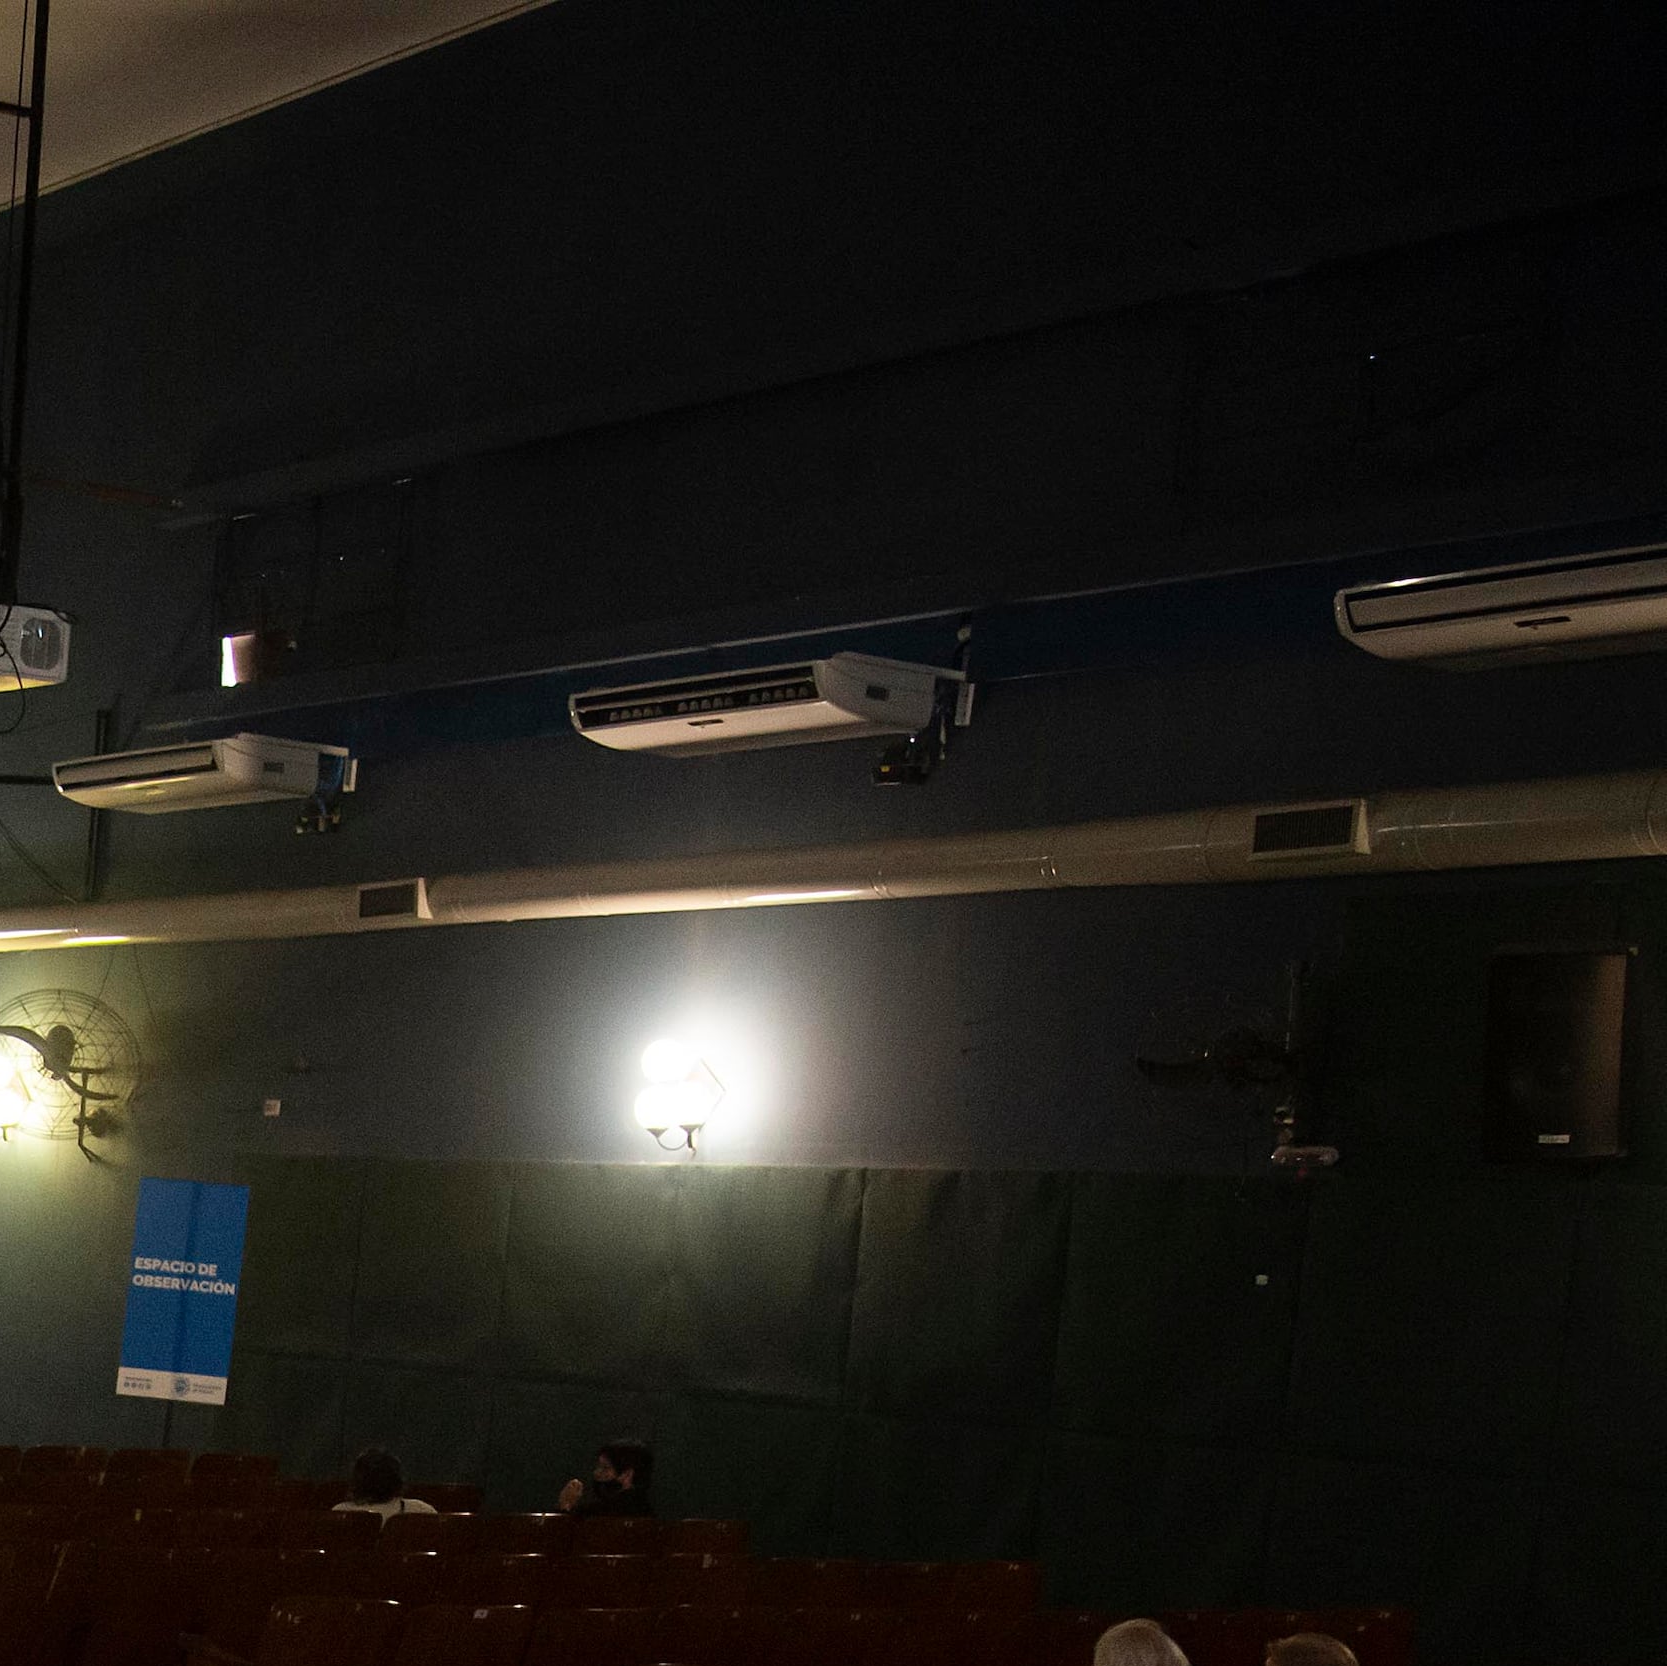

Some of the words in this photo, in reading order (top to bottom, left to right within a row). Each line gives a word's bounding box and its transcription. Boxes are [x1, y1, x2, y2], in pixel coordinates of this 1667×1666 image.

[133, 1256, 196, 1274] ESPACIO
[197, 1262, 218, 1277] DE
[132, 1274, 236, 1296] OBSERVACIÓN
